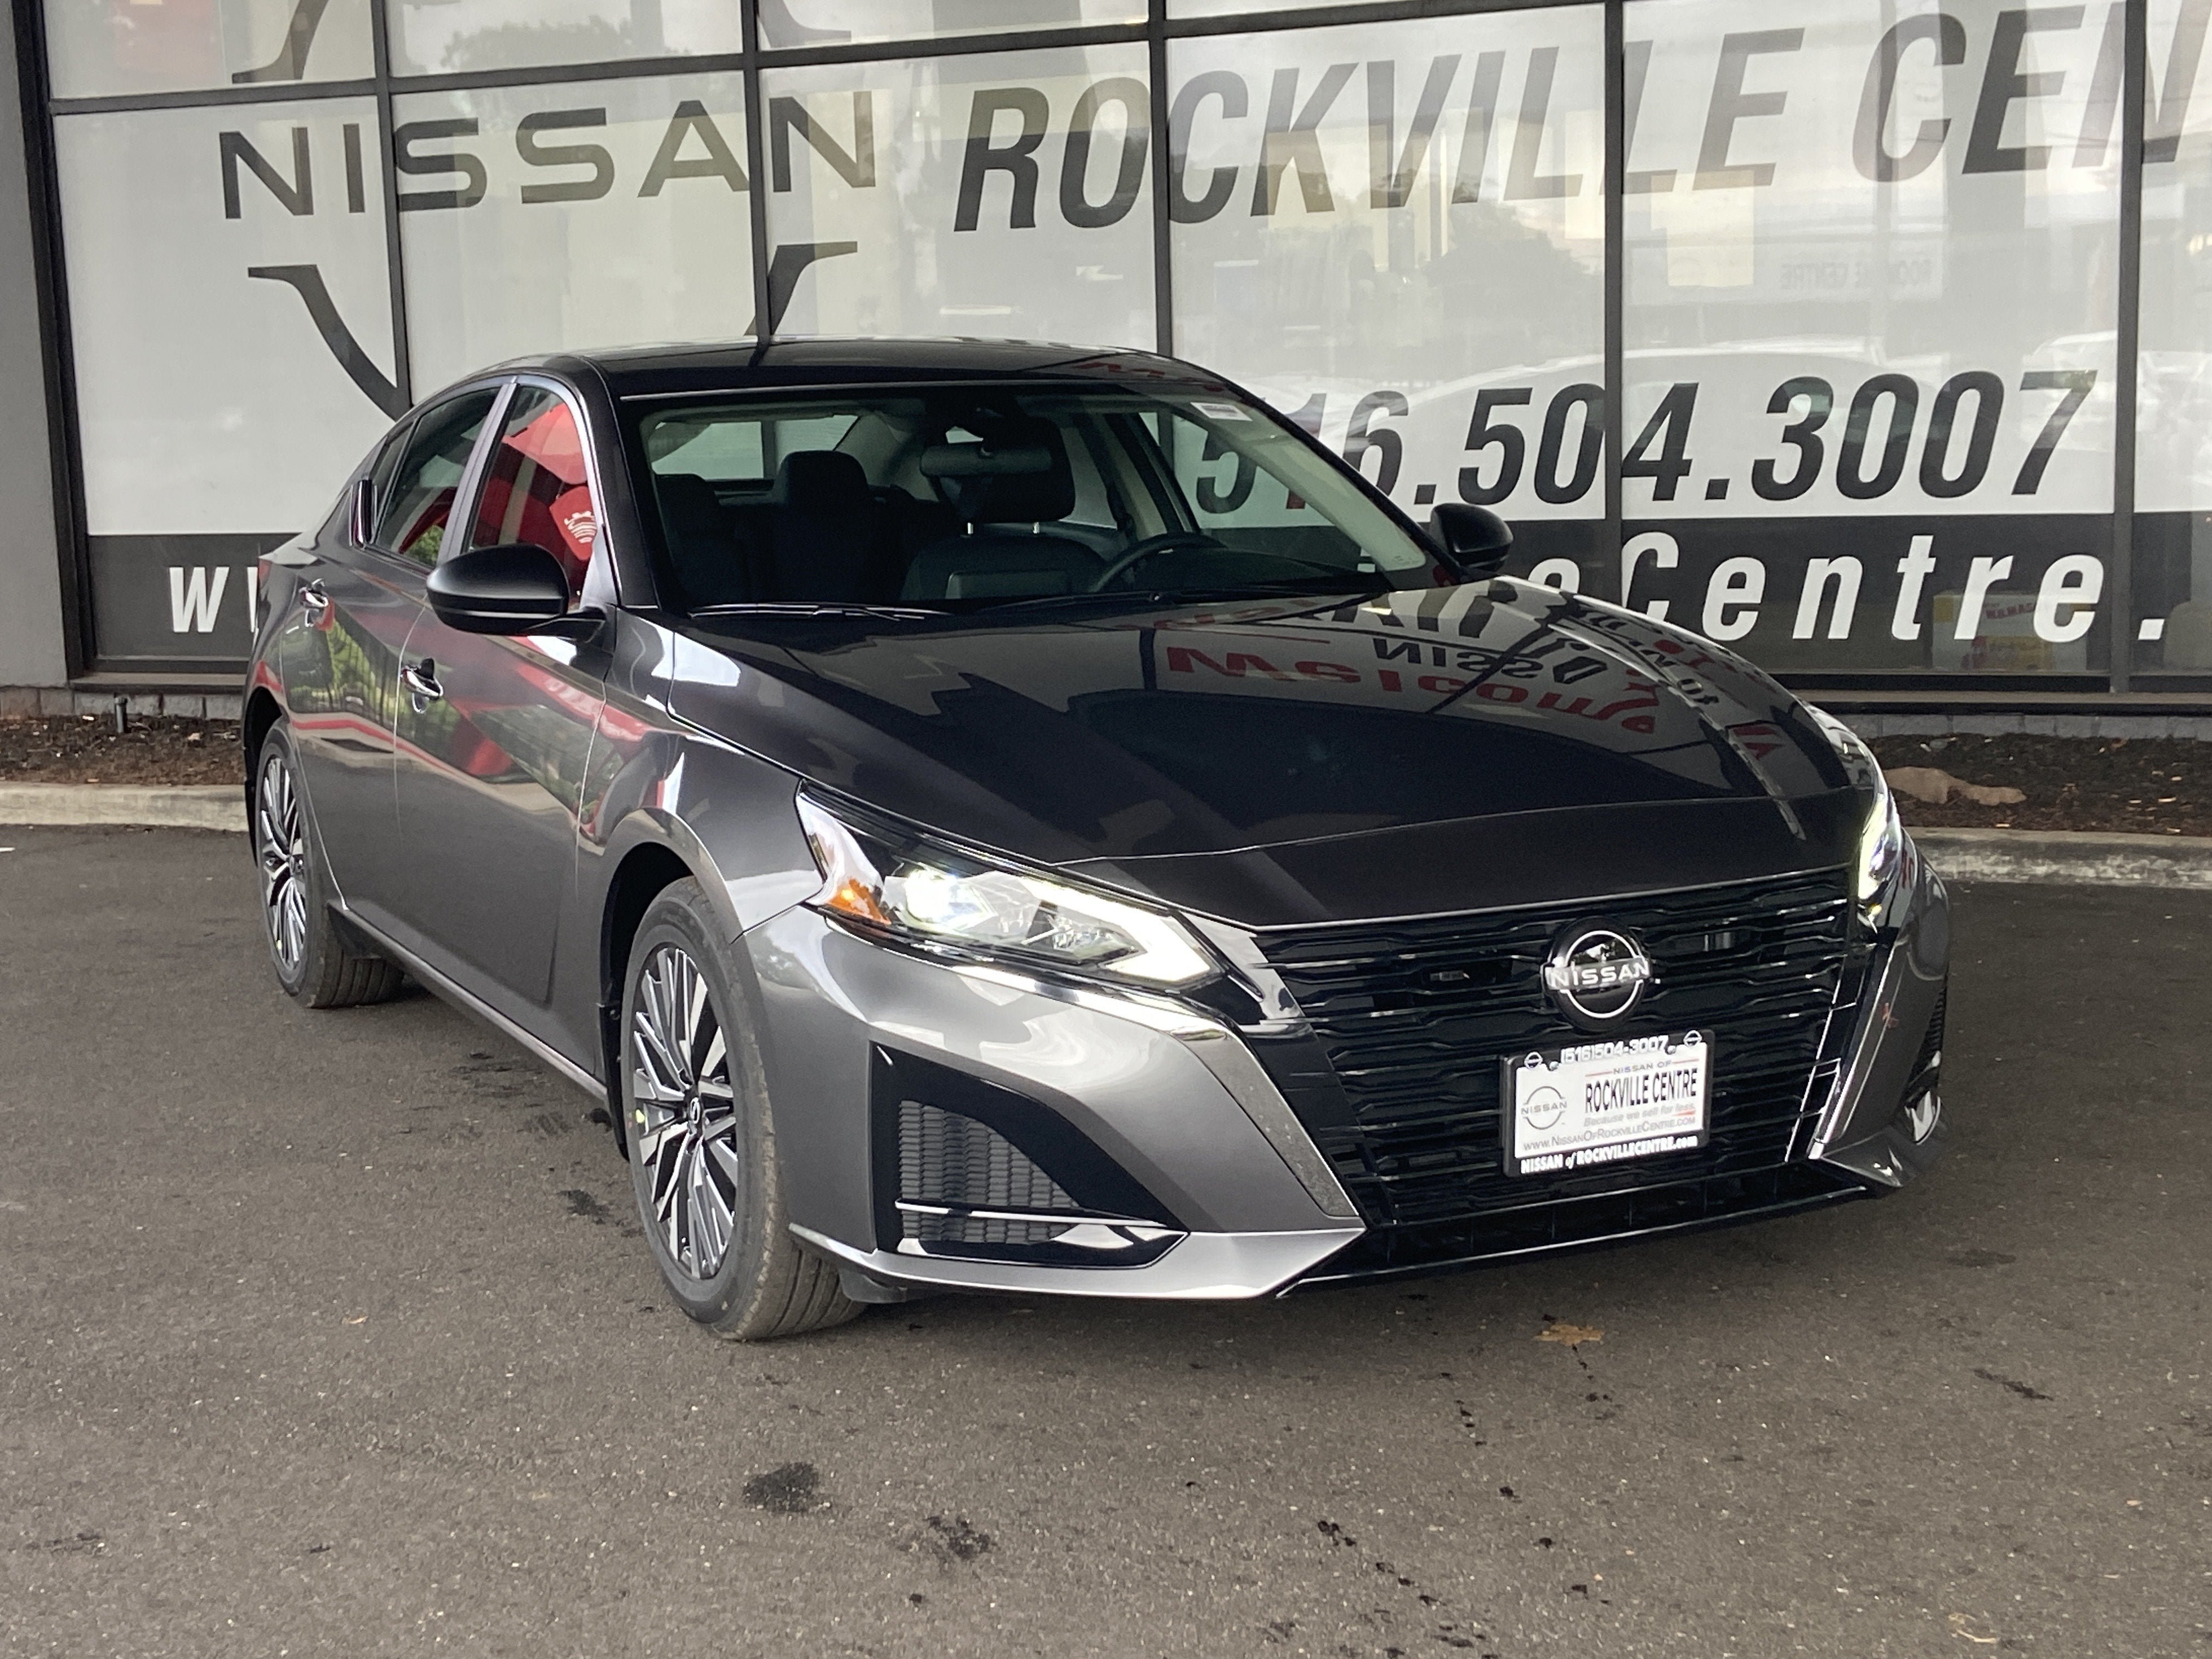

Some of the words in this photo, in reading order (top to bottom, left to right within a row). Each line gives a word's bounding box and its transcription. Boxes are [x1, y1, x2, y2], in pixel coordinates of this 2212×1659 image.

[953, 27, 1805, 232] ROCKVILLE
[219, 91, 876, 219] NISSAN
[1545, 960, 1650, 987] NISSAN
[1613, 1063, 1654, 1074] NISSAN
[1585, 1074, 1649, 1113] ROCKVILLE
[1652, 1068, 1697, 1103] CENTRE
[1521, 1101, 1567, 1115] NISSAN
[1521, 1154, 1563, 1174] NISSAN
[1566, 1152, 1577, 1169] of
